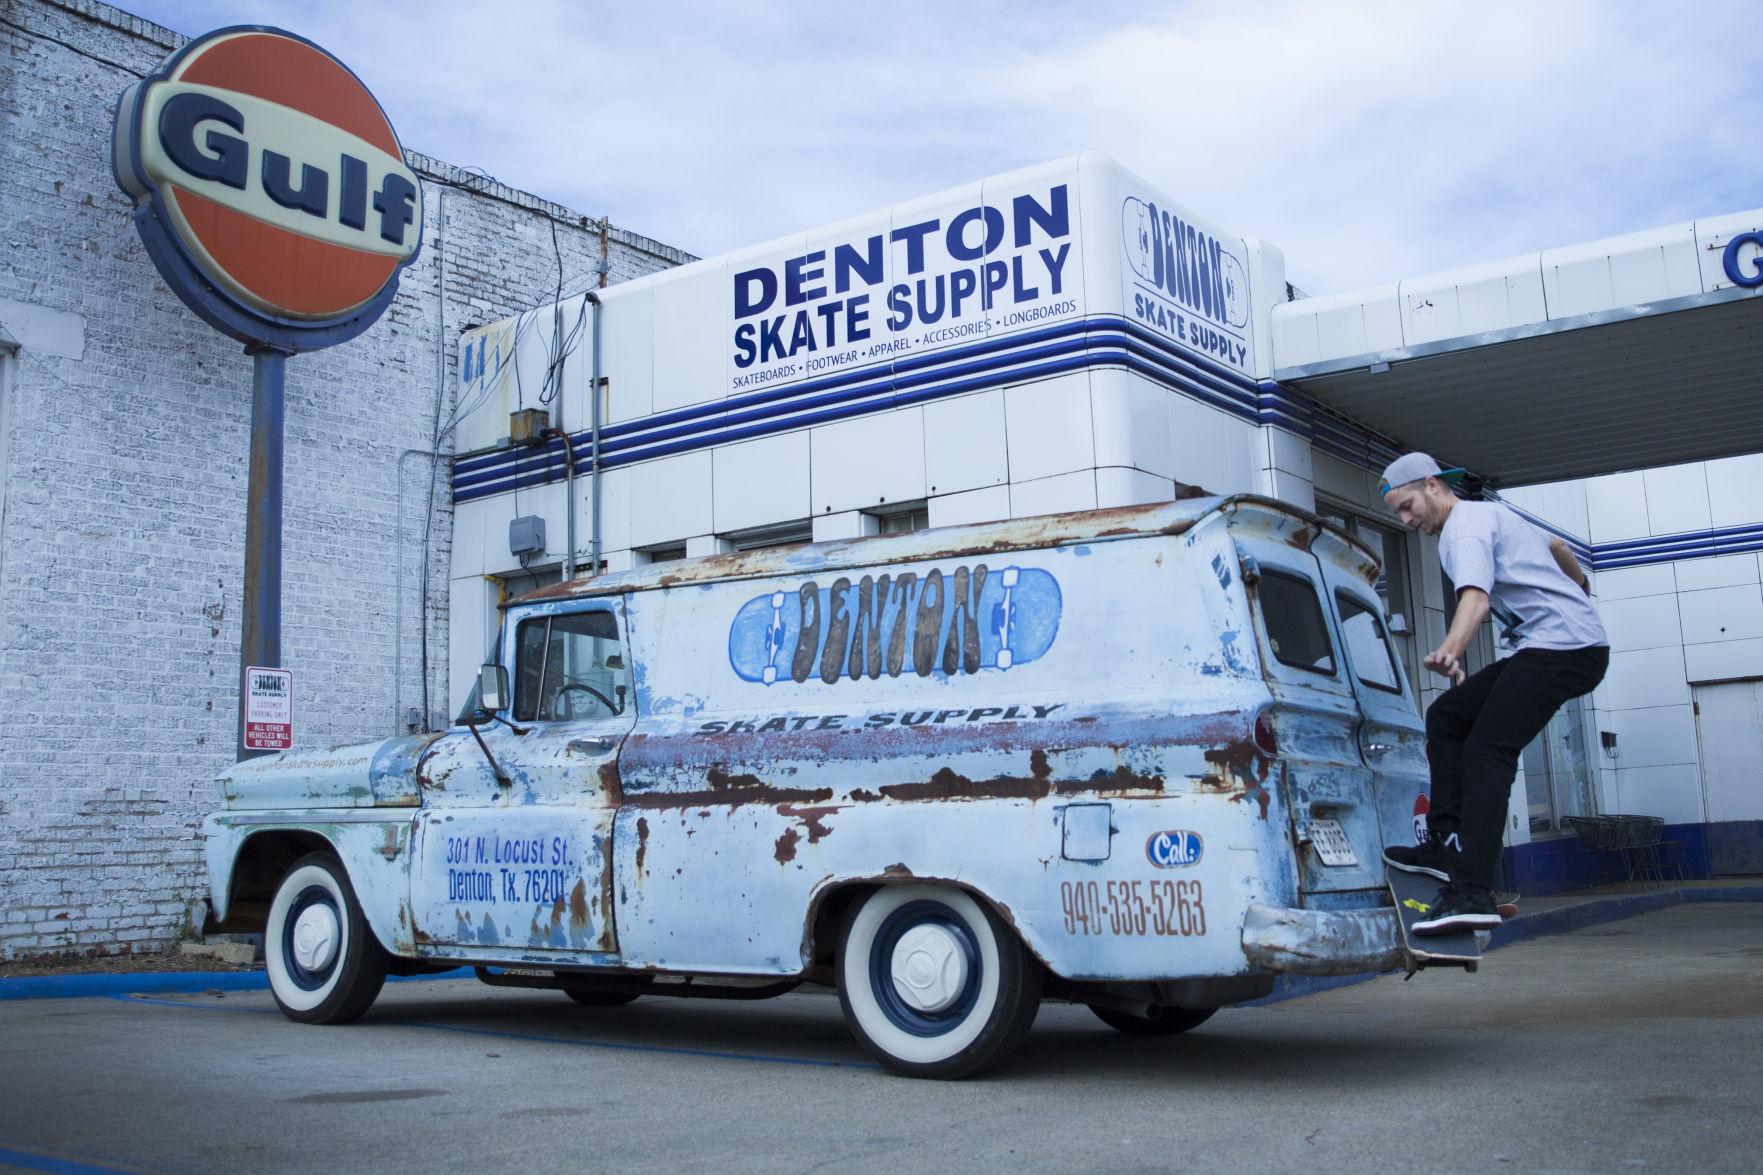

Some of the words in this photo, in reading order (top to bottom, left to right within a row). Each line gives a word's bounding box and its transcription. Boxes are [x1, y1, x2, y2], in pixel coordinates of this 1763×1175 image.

[159, 92, 416, 246] Gulf
[734, 184, 1070, 320] DENTON
[1149, 202, 1227, 325] DENTON
[734, 294, 871, 369] SKATE
[886, 242, 1071, 332] SUPPLY
[1135, 293, 1186, 341] SKATE
[1190, 322, 1247, 367] SUPPLY
[733, 365, 796, 389] SKATEBOARDS
[806, 351, 858, 373] FOOTWEAR
[868, 337, 911, 358] APPAREL
[922, 319, 992, 345] ACCESSORIES
[1003, 300, 1076, 327] LONGBOARDS
[791, 563, 989, 685] DENTON
[248, 732, 276, 740] VEHICLES
[276, 732, 290, 740] WILL
[254, 724, 265, 732] ALL
[696, 714, 848, 737] SKATE
[864, 703, 1064, 729] SUPPLY
[233, 755, 368, 773] dentonskatesupply.com
[447, 837, 470, 864] 301
[475, 836, 489, 864] N.
[495, 836, 545, 864] Locust
[552, 836, 573, 866] St.
[1154, 830, 1195, 864] Call:
[449, 869, 496, 904] Denton,
[525, 869, 566, 904] 76201
